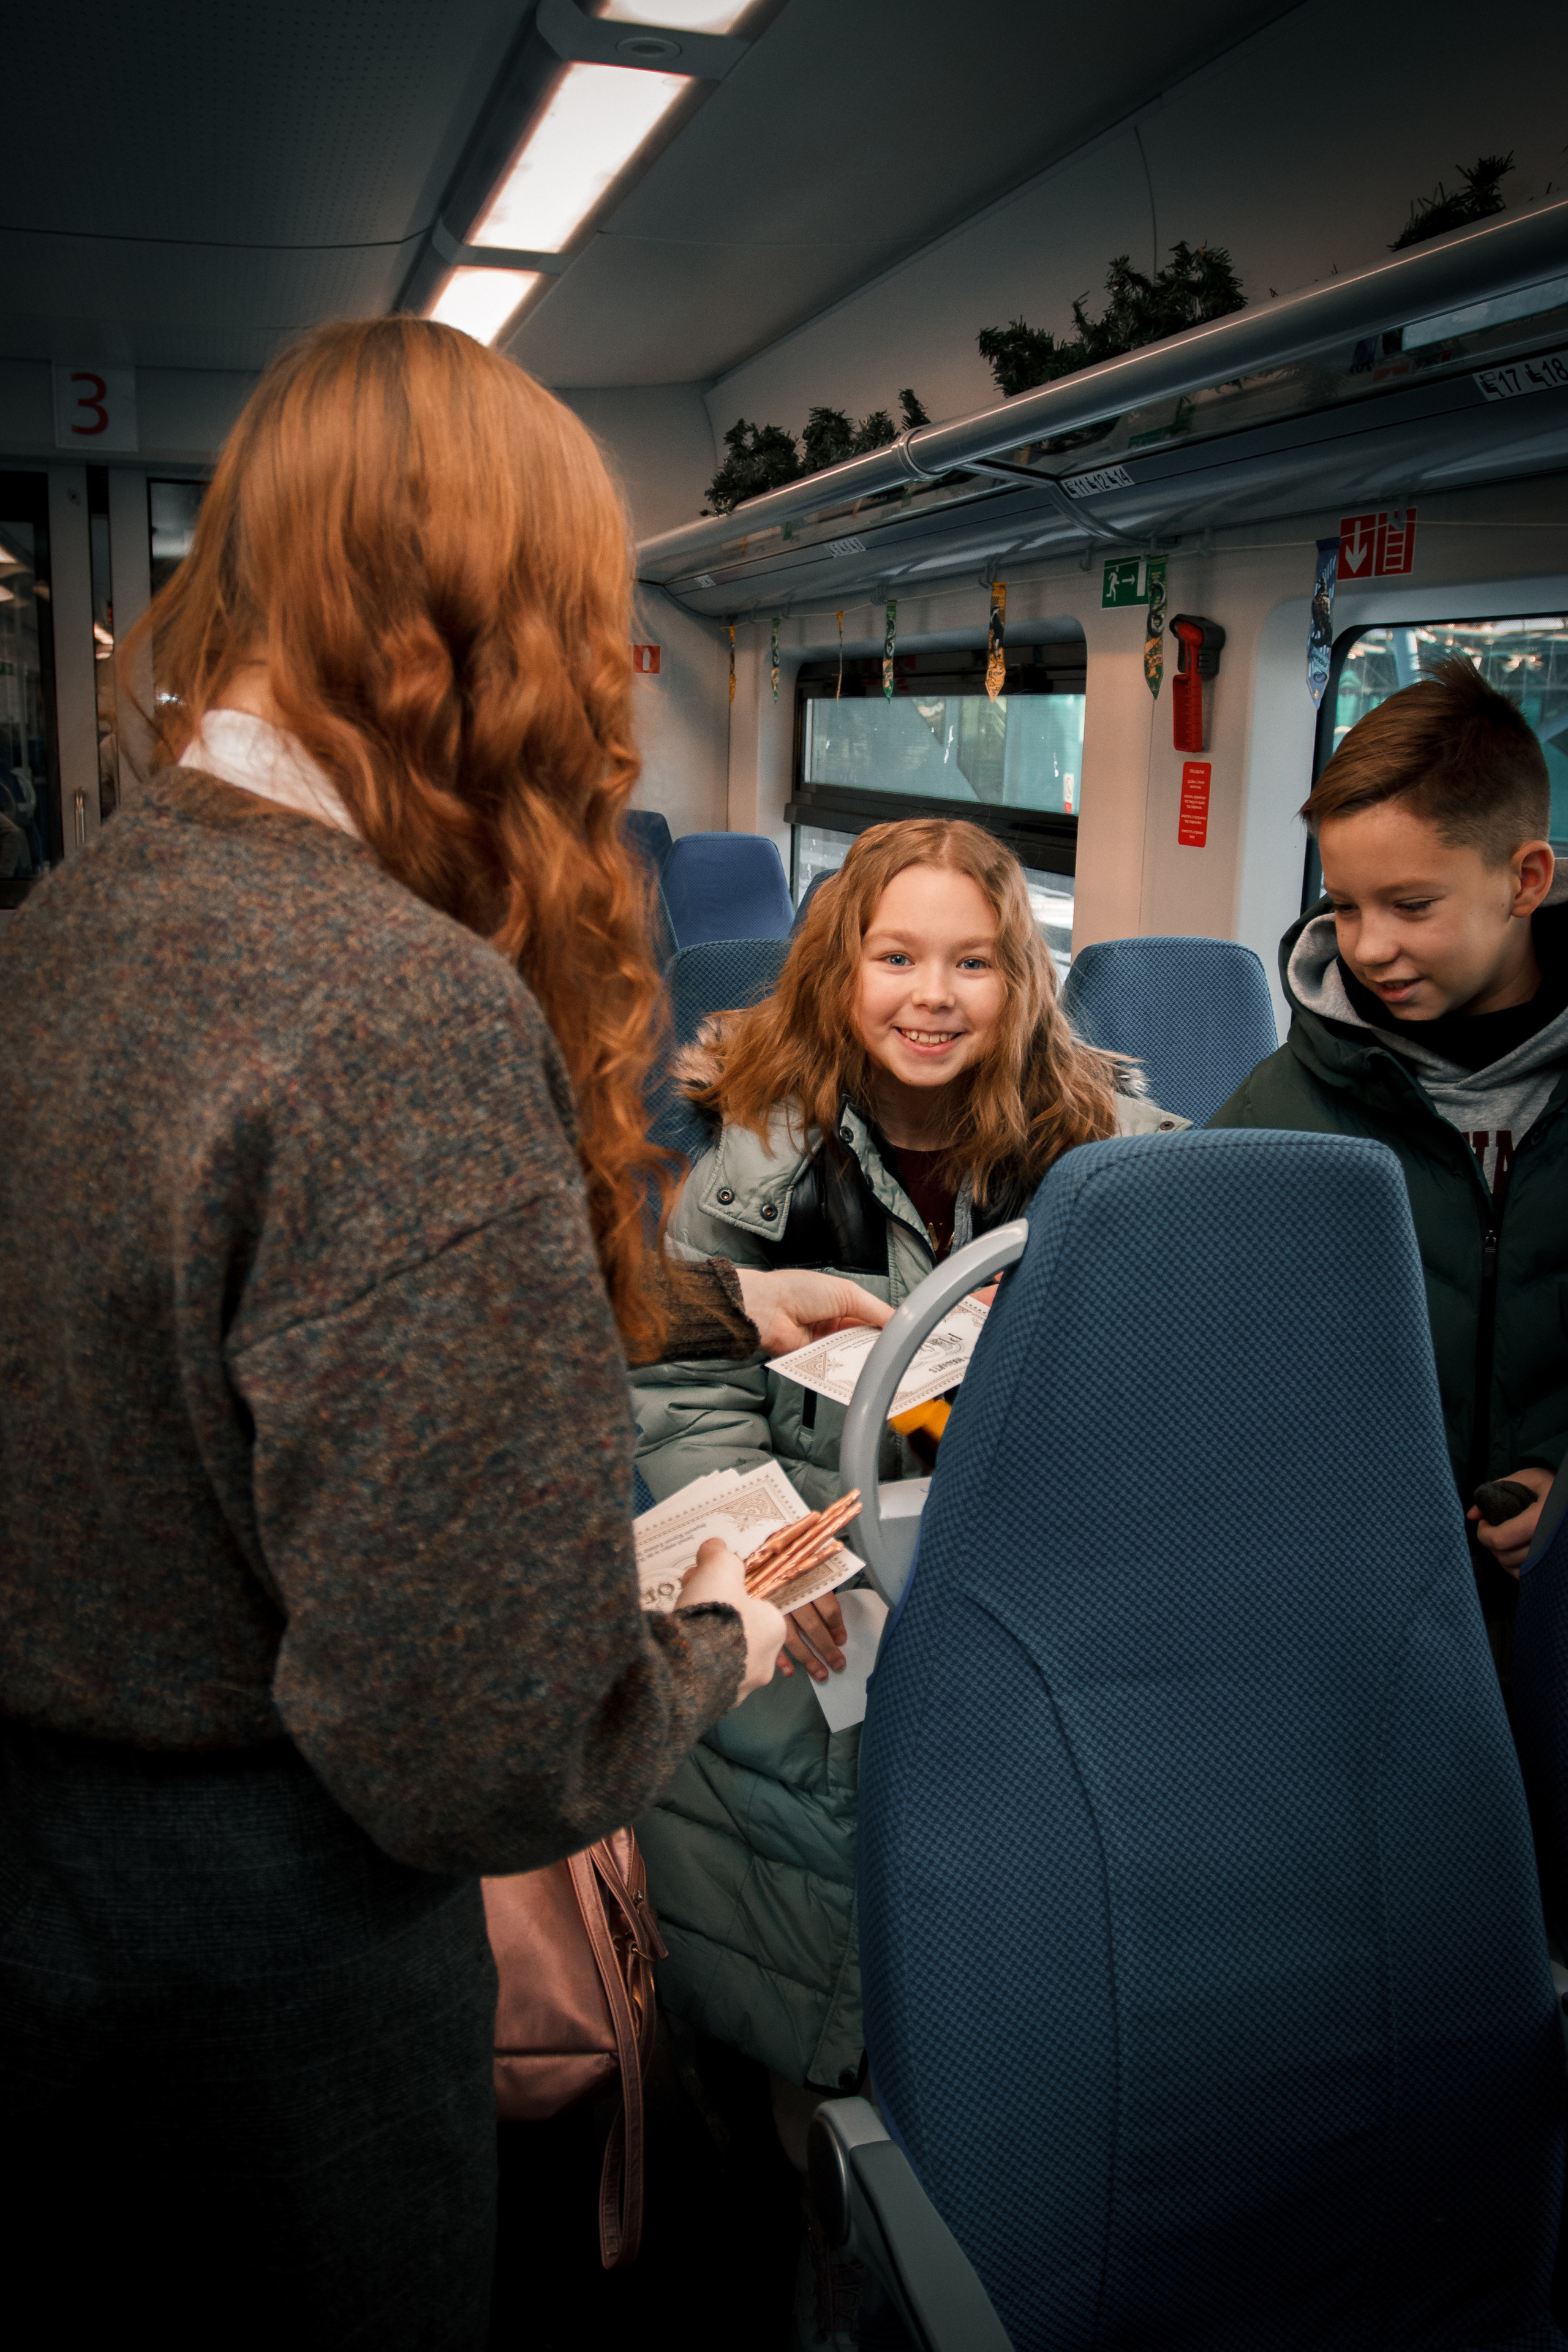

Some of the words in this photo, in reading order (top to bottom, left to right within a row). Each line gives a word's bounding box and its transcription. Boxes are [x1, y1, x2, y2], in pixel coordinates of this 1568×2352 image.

[1498, 369, 1521, 393] 17
[1542, 358, 1568, 383] 18
[71, 372, 108, 435] 3
[1074, 479, 1090, 495] 11
[1093, 473, 1110, 491] 12
[1114, 468, 1131, 485] 14
